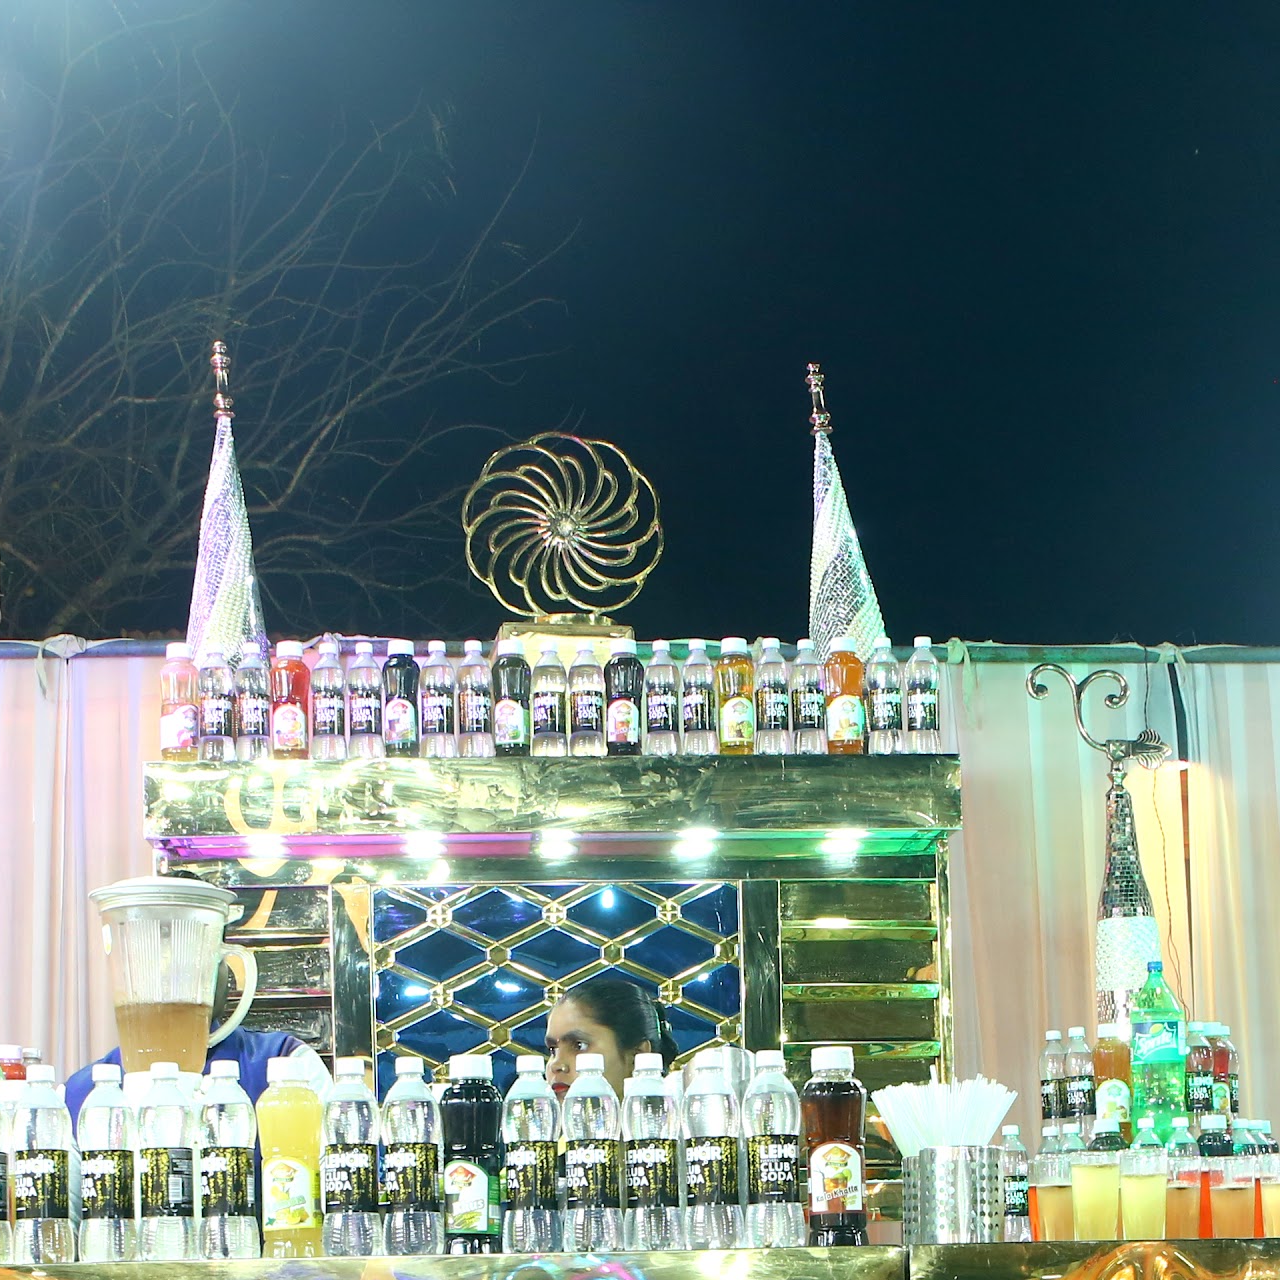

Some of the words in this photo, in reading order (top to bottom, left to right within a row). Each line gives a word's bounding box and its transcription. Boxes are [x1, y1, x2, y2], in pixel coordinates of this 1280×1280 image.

[760, 1162, 791, 1172] CLUB
[760, 1172, 794, 1182] SODA
[834, 1186, 859, 1199] Khatta
